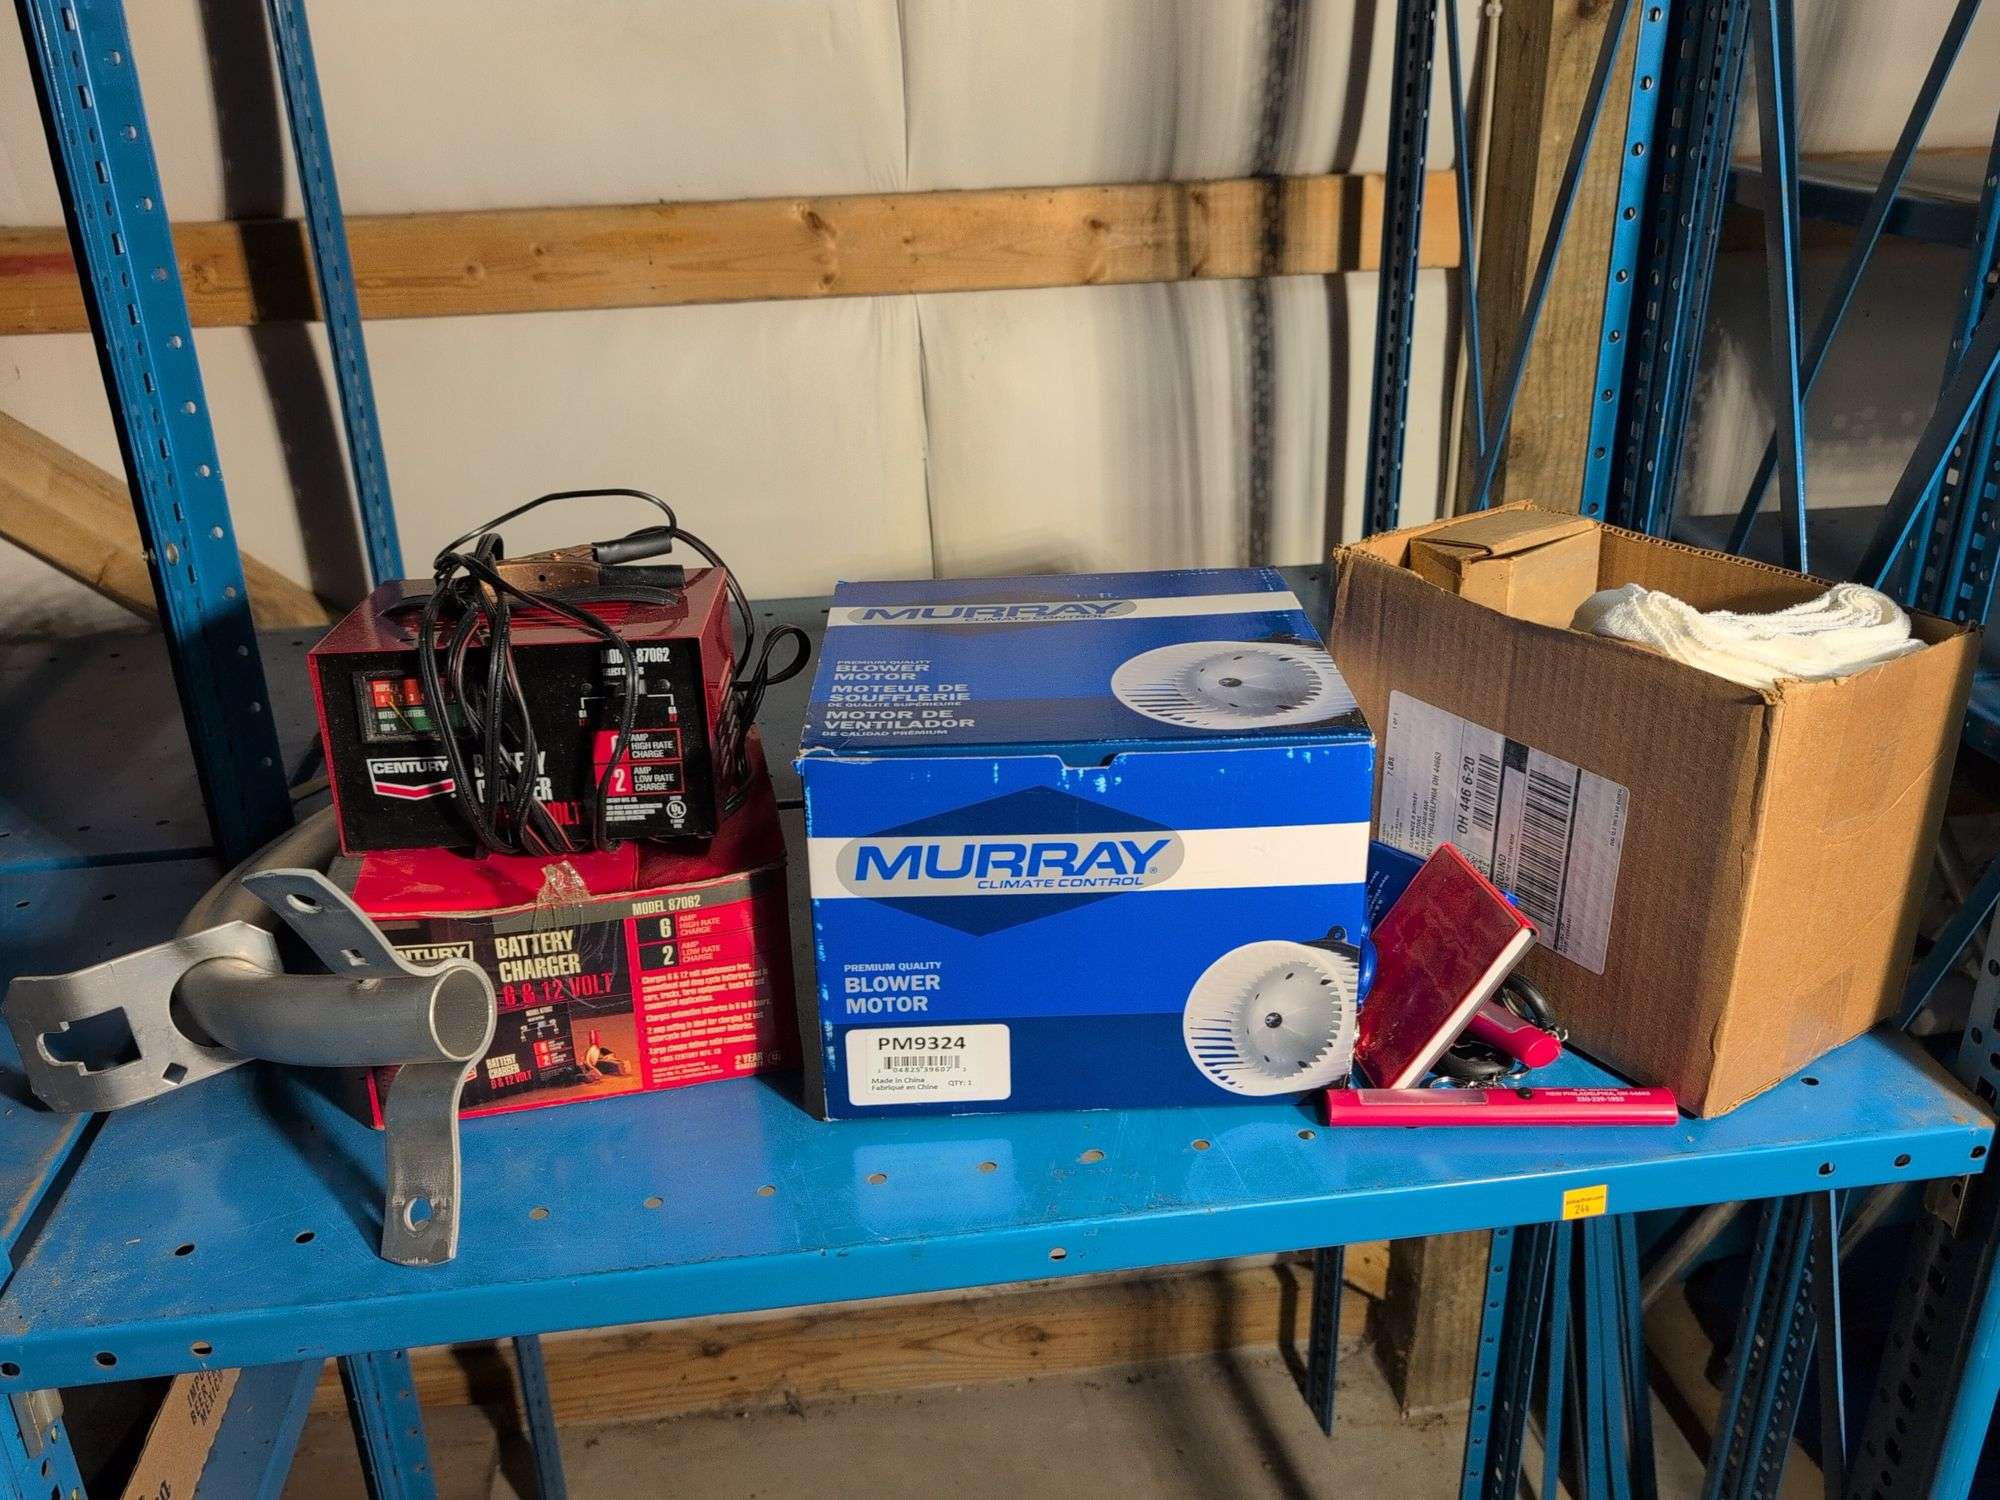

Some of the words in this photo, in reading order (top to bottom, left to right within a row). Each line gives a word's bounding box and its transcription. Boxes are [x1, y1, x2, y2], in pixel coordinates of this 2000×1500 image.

[862, 601, 1123, 620] MURRAY
[635, 647, 670, 663] 87062
[835, 664, 930, 672] BLOWER
[831, 685, 930, 693] MOTEUR
[938, 684, 968, 692] DE
[829, 693, 971, 702] SOUFFLERIE
[826, 710, 913, 719] MOTOR
[922, 709, 954, 719] DE
[824, 719, 976, 730] VENTILADOR
[630, 733, 649, 742] AMP
[631, 741, 651, 751] HIGH
[652, 740, 673, 749] RATE
[631, 750, 664, 759] CHARGE
[372, 760, 449, 775] CENTURY
[633, 766, 652, 775] AMP
[1462, 756, 1475, 785] 6-20
[613, 768, 627, 792] 2
[634, 774, 653, 783] LOW
[653, 773, 675, 783] RATE
[1432, 775, 1440, 785] OH
[634, 782, 668, 792] CHARGE
[1460, 788, 1472, 811] 446
[1427, 787, 1438, 838] PHILADELPHIA
[1456, 815, 1468, 834] OH
[855, 839, 1172, 881] MURRAY
[977, 878, 1055, 890] CLIMATE
[1057, 876, 1145, 888] CONTROL
[632, 900, 665, 916] MODEL
[679, 913, 698, 922] AMP
[680, 920, 701, 930] HIGH
[701, 917, 721, 926] RATE
[658, 917, 672, 938] 6
[680, 926, 712, 936] CHARGE
[494, 929, 574, 960] BATTERY
[682, 940, 699, 949] AMP
[682, 946, 700, 956] LOW
[398, 944, 467, 962] NTURY
[662, 945, 675, 966] 2
[682, 953, 714, 963] CHARGE
[498, 953, 582, 984] CHARGER
[844, 963, 896, 973] PREMIUM
[898, 961, 942, 972] QUALITY
[502, 986, 516, 1006] 6
[522, 982, 536, 1003] &
[543, 978, 565, 1001] 12
[570, 971, 614, 997] VOLT
[844, 974, 941, 994] BLOWER
[846, 995, 929, 1015] MOTOR
[878, 1036, 966, 1051] PM9324
[515, 1069, 533, 1084] VOLT
[894, 1076, 902, 1084] in
[904, 1076, 925, 1084] China
[917, 1083, 938, 1091] Chine
